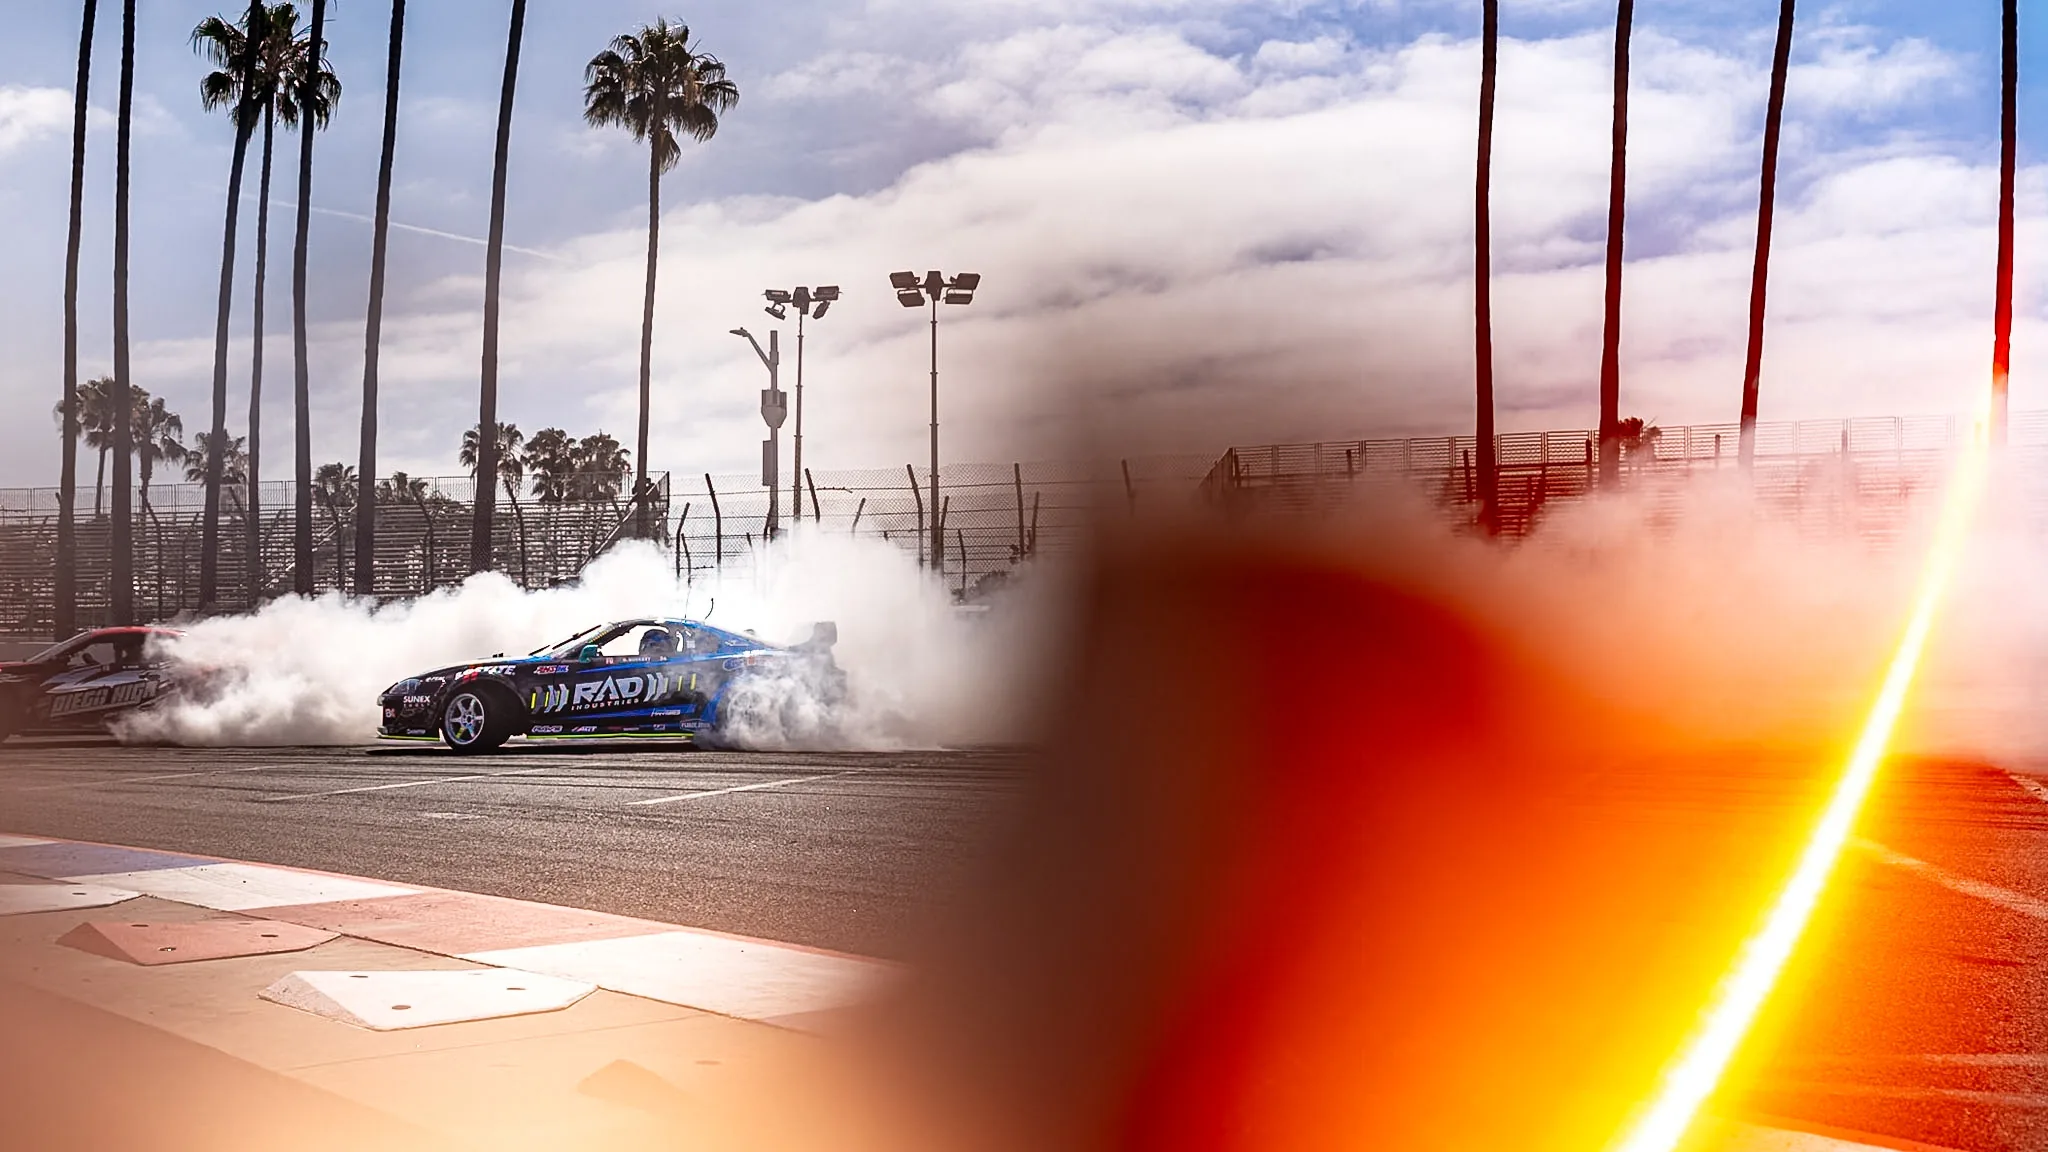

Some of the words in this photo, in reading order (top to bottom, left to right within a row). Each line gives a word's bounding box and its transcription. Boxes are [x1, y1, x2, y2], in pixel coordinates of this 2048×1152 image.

[573, 675, 643, 704] RAD
[402, 695, 431, 703] SUNEX
[571, 698, 640, 711] INDUSTRIES
